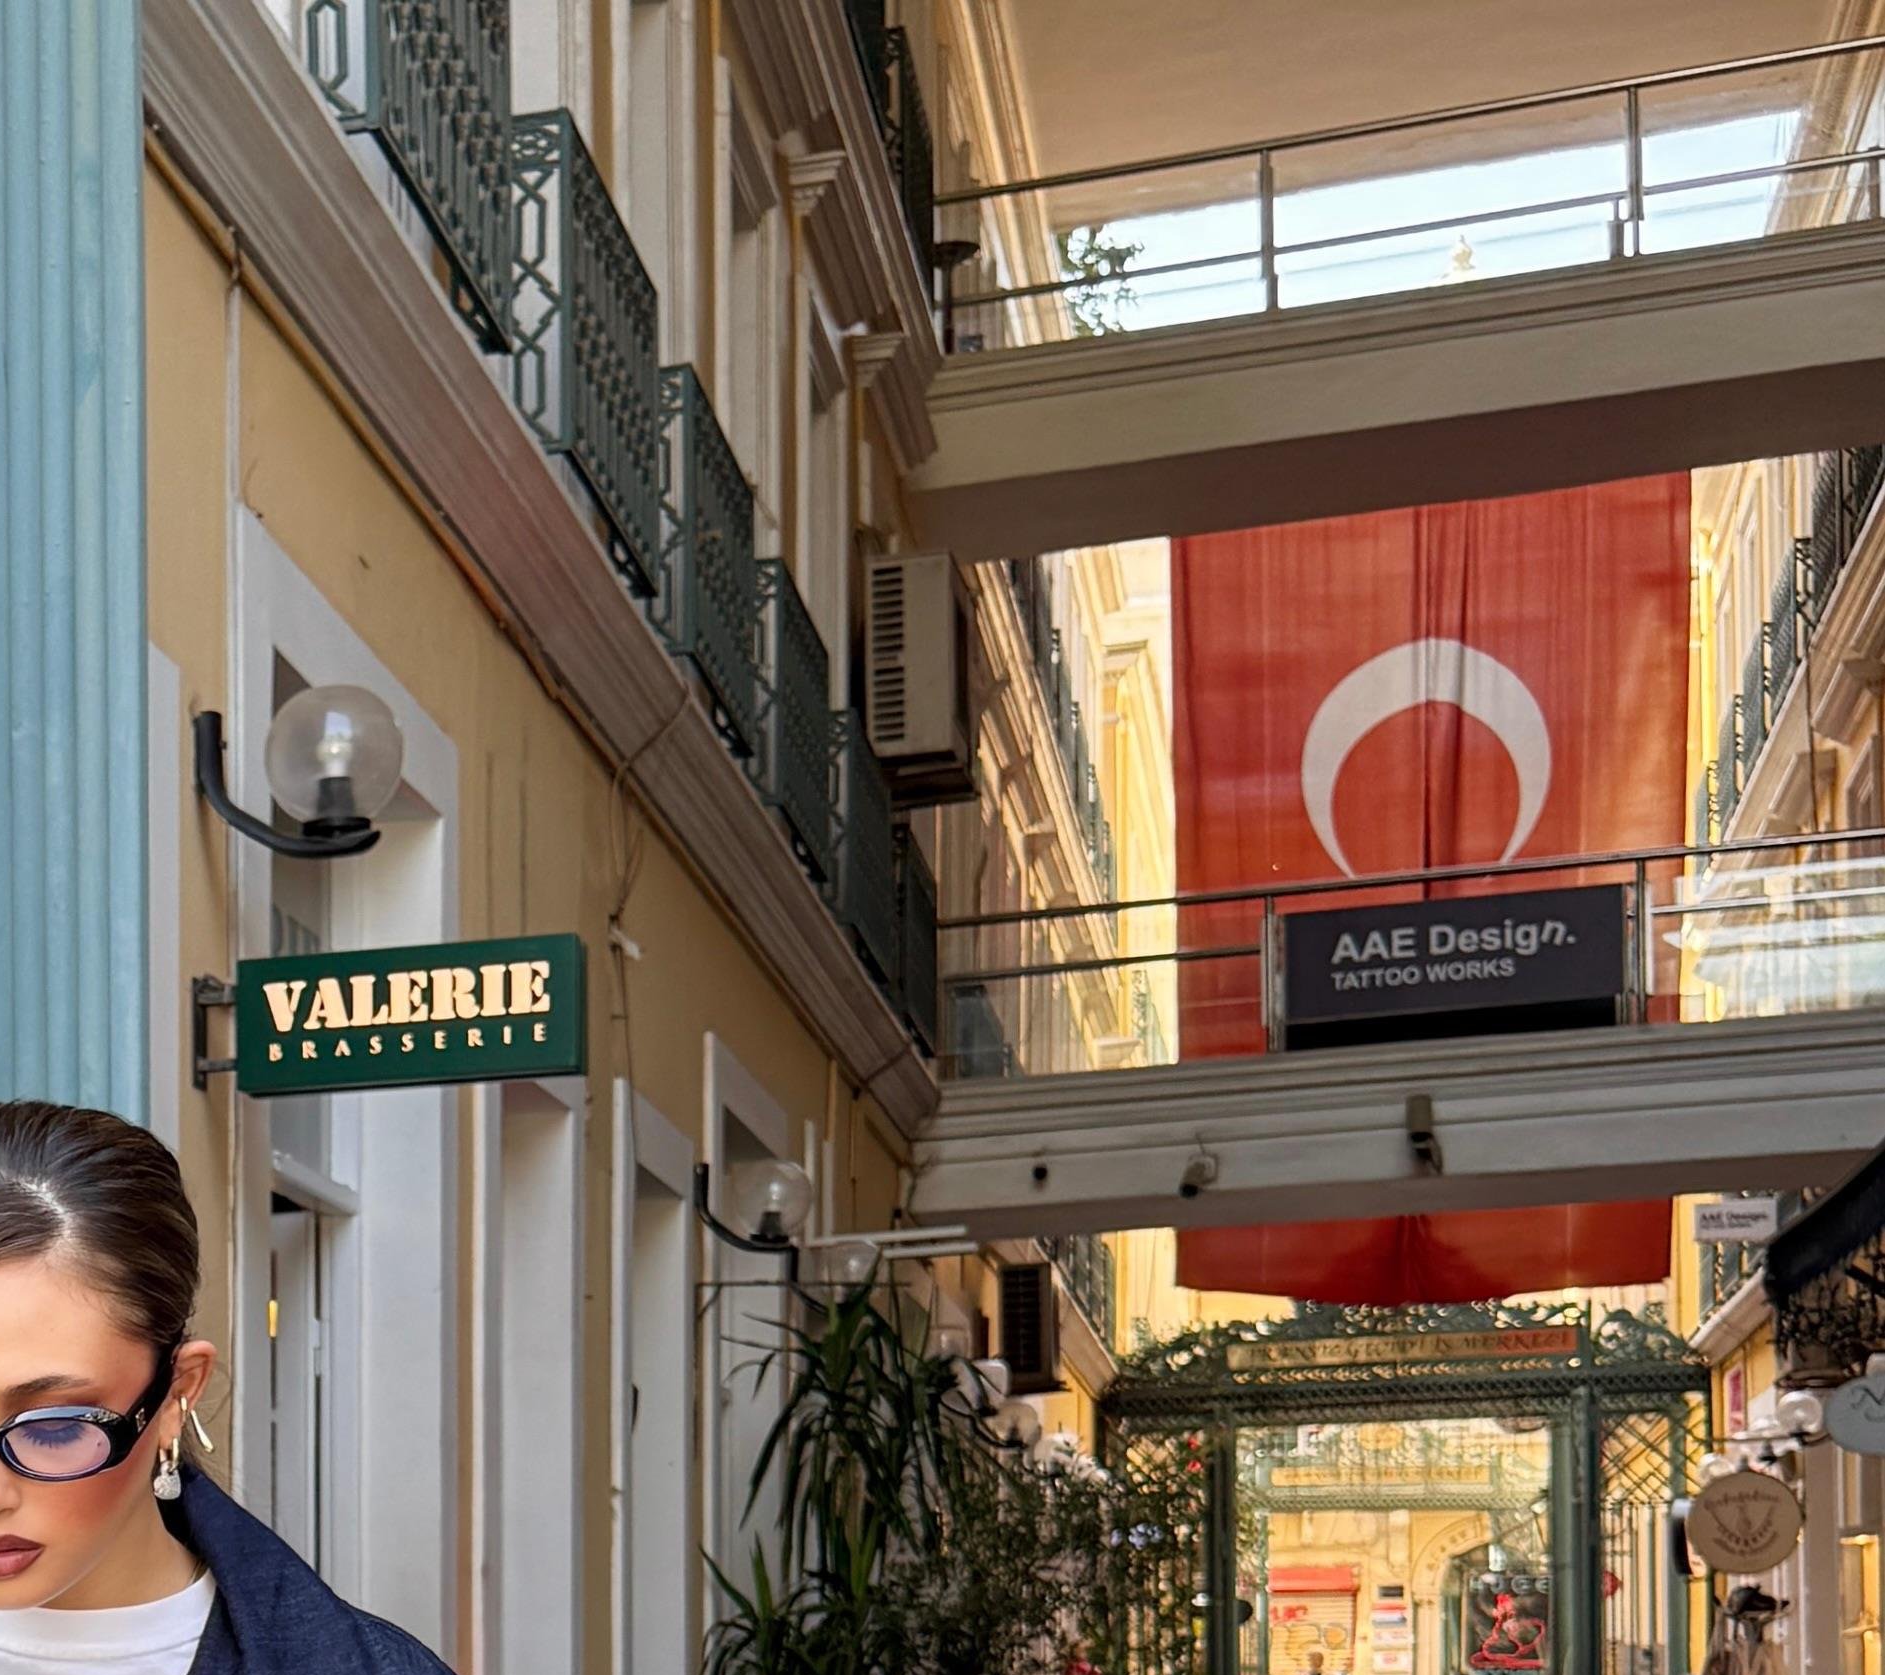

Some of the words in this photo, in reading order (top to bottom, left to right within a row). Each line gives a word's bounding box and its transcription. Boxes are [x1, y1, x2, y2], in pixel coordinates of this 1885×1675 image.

[1331, 926, 1417, 965] AAE
[1428, 917, 1577, 957] Design.
[263, 960, 552, 1033] VALERIE
[1331, 966, 1421, 992] TATTOO
[1427, 957, 1517, 983] WORKS
[268, 1022, 548, 1063] BRASSERIE
